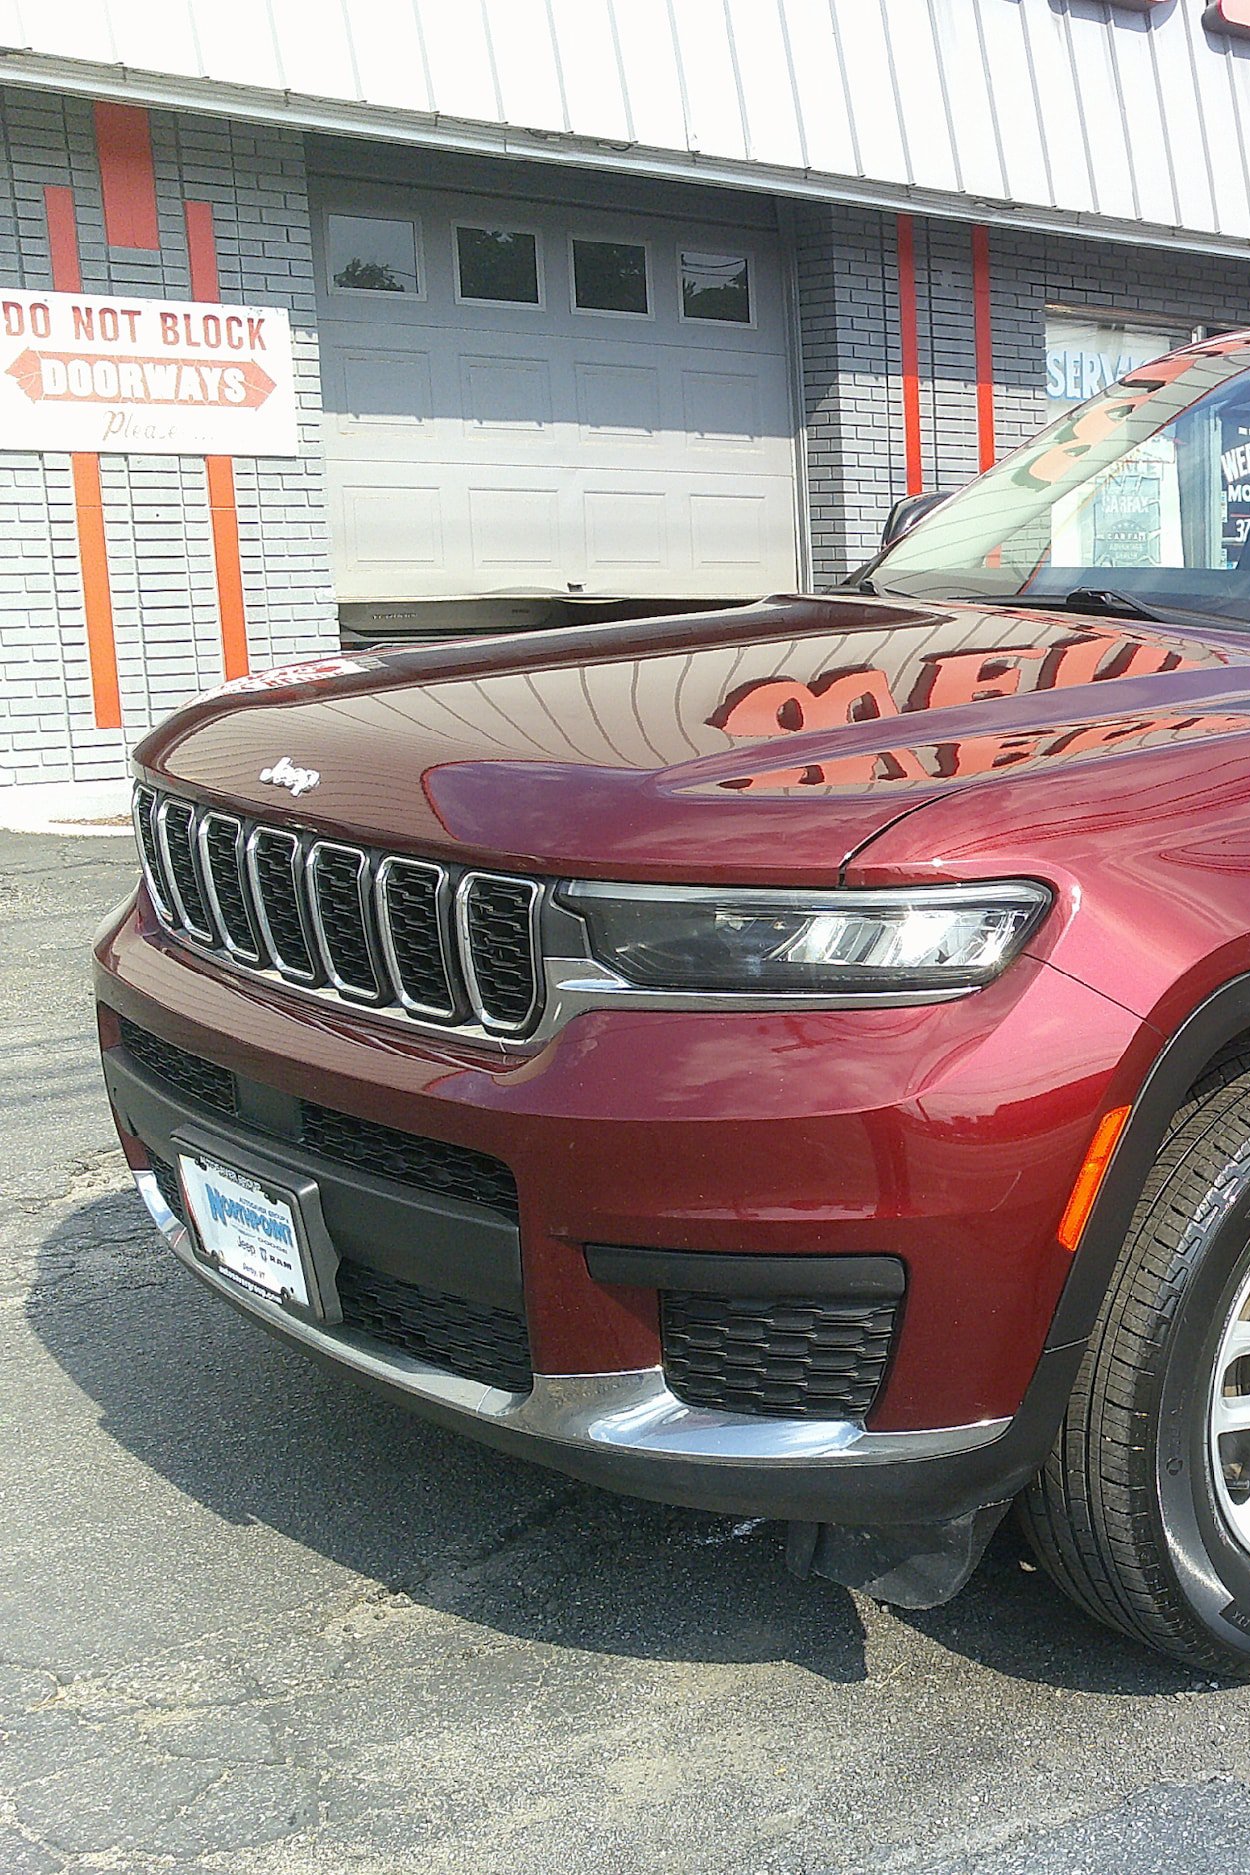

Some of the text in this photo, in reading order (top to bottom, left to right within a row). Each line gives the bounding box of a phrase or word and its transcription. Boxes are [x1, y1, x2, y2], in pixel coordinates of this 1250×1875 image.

[2, 301, 267, 351] DO NOT BLOCK
[41, 358, 247, 403] DOORWAYS
[102, 410, 177, 442] Pleae
[259, 757, 320, 797] Jeep
[238, 1236, 292, 1270] Jeep RAM
